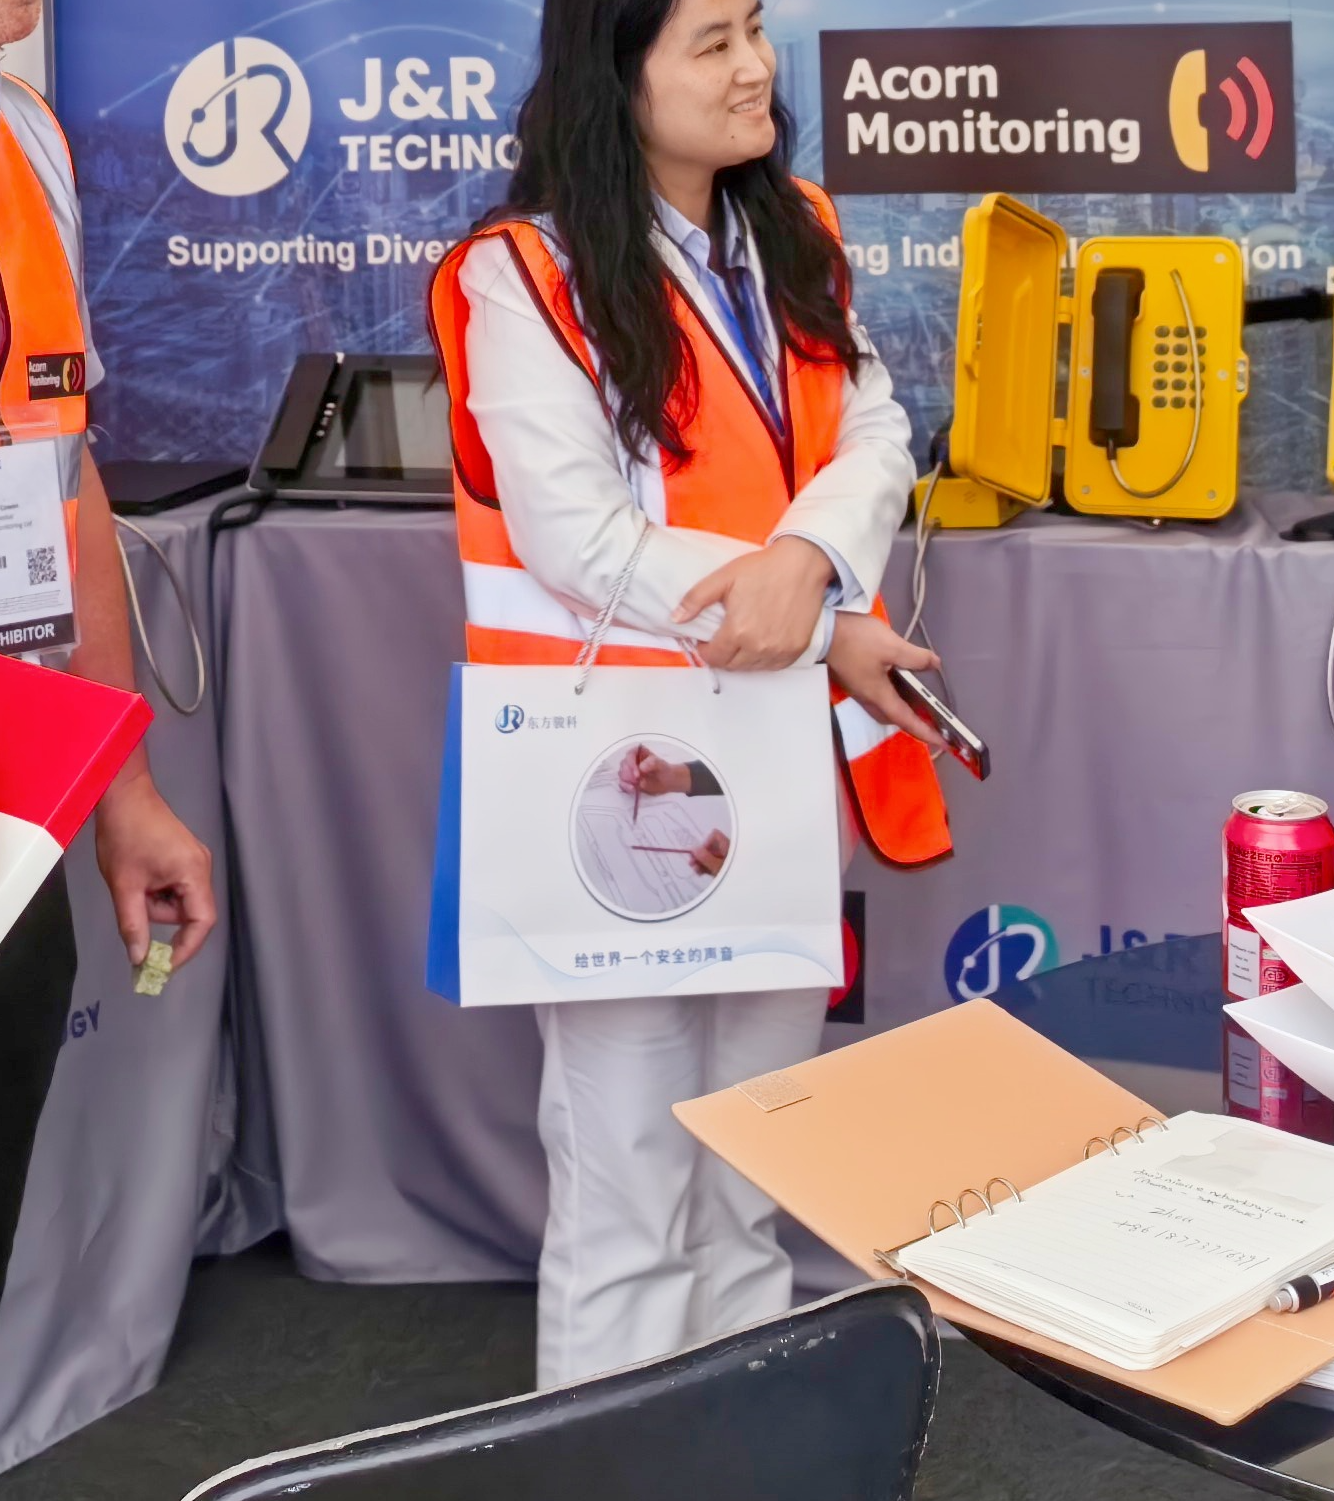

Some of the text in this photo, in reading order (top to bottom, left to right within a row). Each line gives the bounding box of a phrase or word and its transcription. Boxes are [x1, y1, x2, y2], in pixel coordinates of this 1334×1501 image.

[339, 55, 497, 121] J&R
[843, 58, 1000, 101] Acorn
[846, 110, 1141, 164] Monitoring
[168, 234, 356, 272] Supporting
[574, 946, 734, 969] 给世界一个安全的声音
